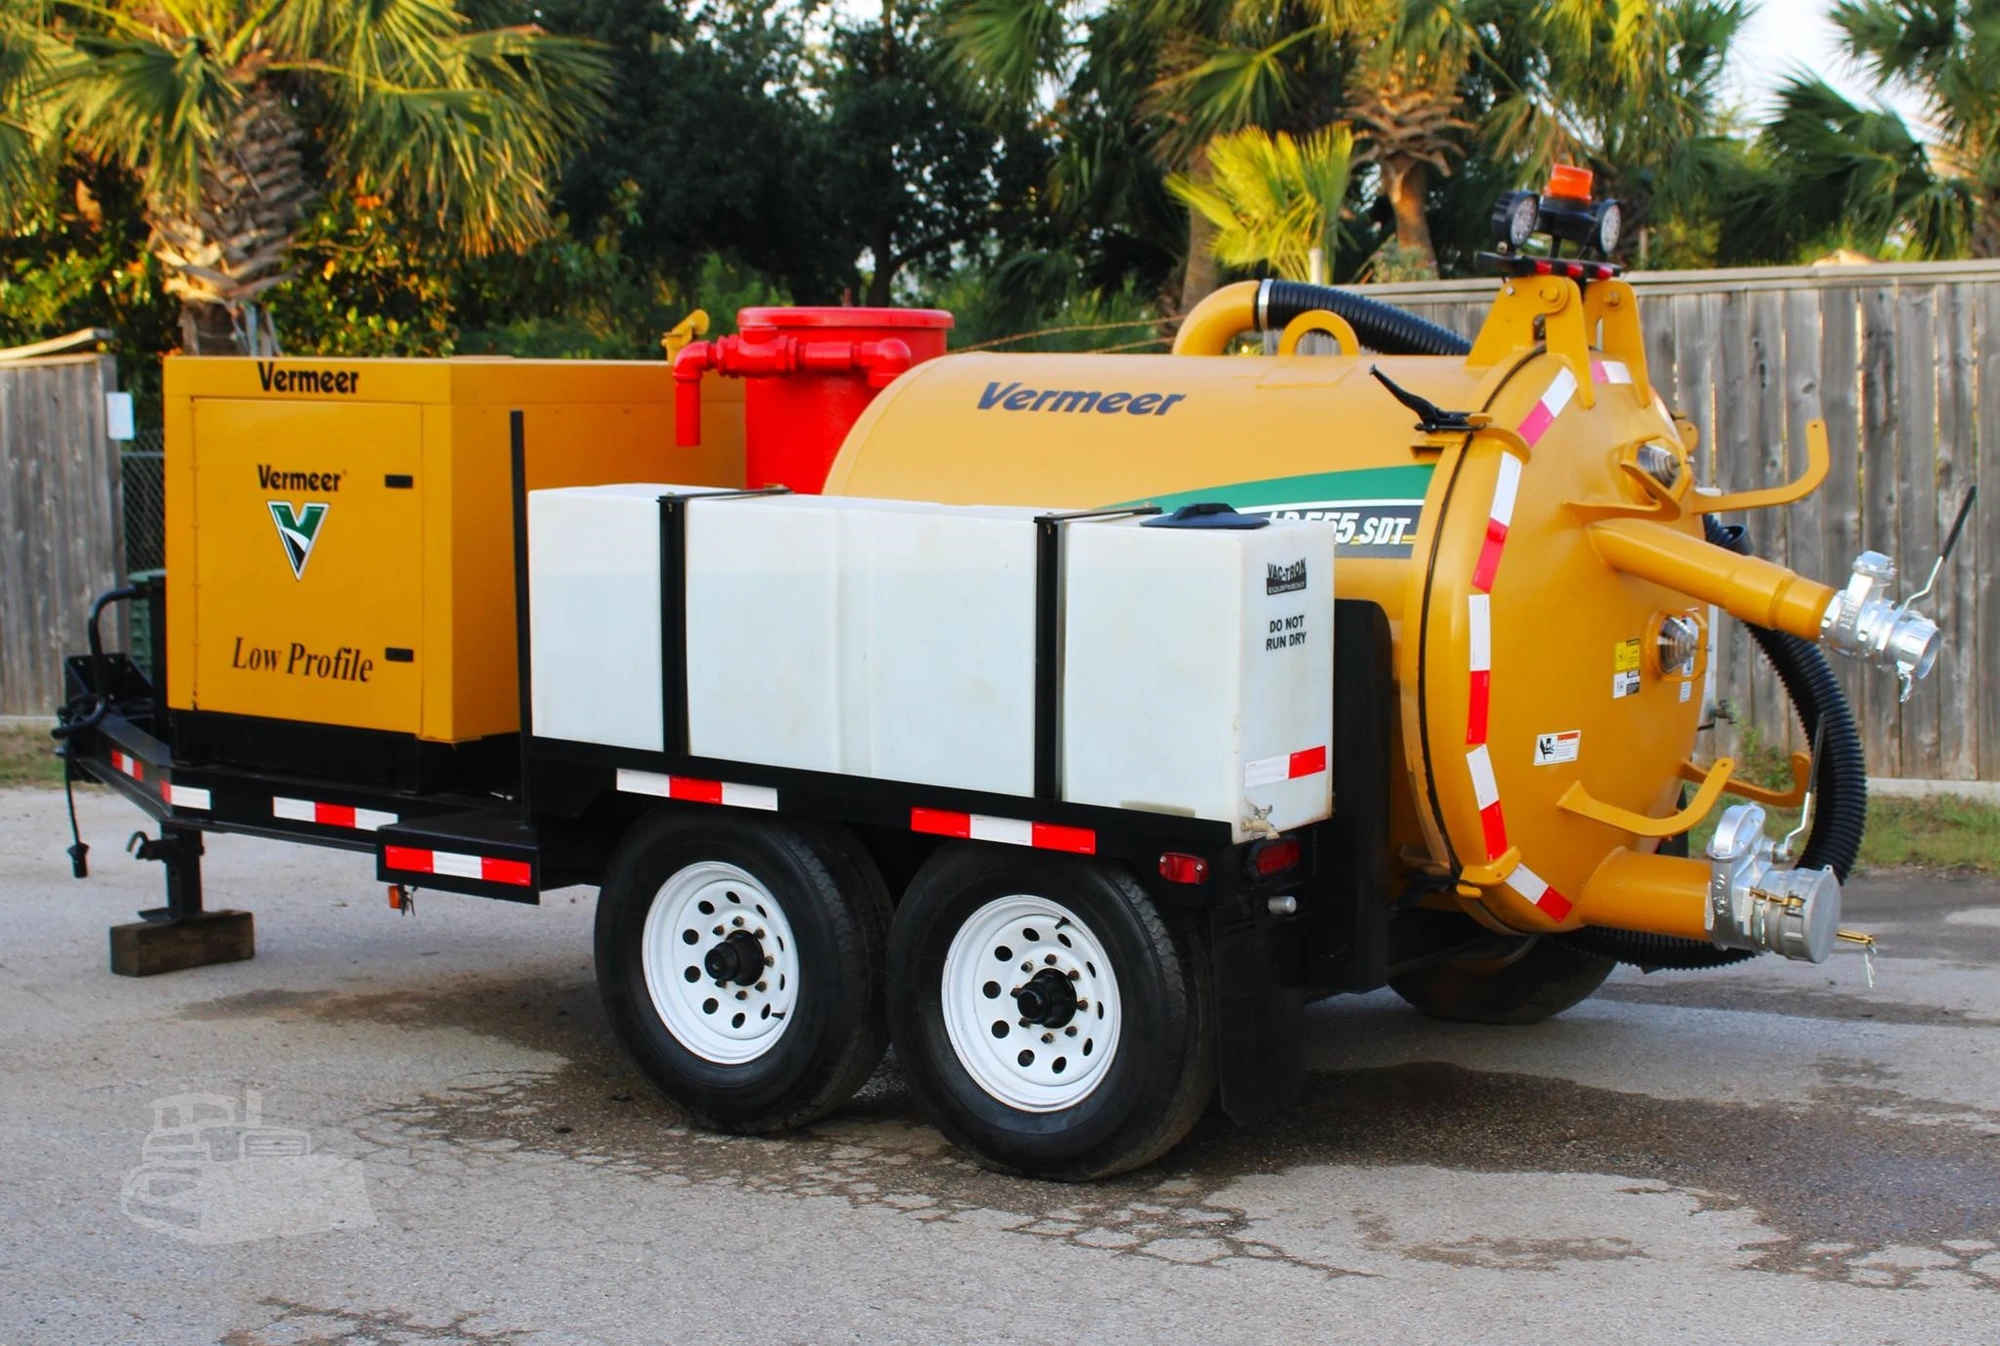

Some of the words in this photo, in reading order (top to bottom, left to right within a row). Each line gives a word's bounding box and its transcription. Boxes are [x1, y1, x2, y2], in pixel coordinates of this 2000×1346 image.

[257, 361, 359, 394] Vermeer
[977, 381, 1187, 416] Vermeer
[1359, 517, 1412, 545] SDT
[1267, 557, 1306, 582] VAC-TRON
[1269, 619, 1283, 633] DO
[1285, 615, 1305, 629] NOT
[1265, 637, 1287, 651] RUN
[1288, 632, 1307, 647] DRY
[232, 636, 282, 672] Low
[286, 642, 374, 682] Profile
